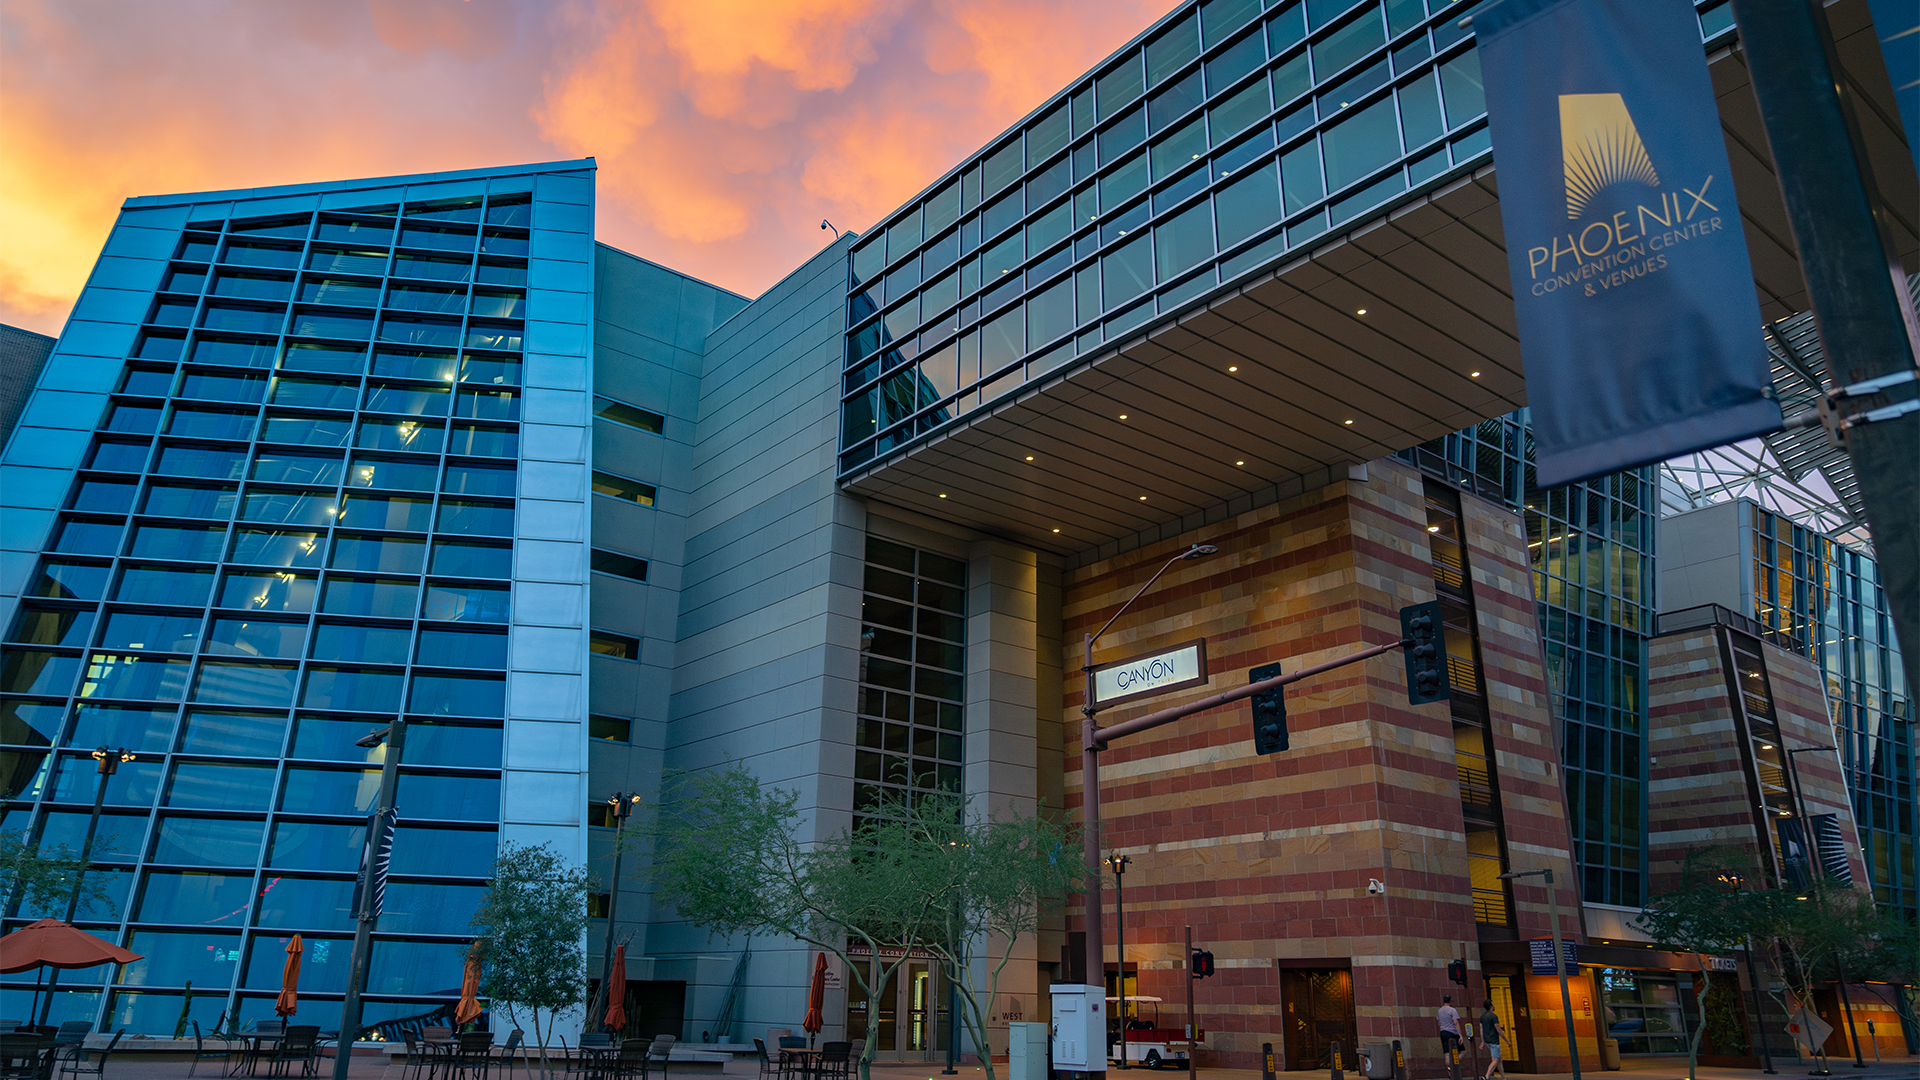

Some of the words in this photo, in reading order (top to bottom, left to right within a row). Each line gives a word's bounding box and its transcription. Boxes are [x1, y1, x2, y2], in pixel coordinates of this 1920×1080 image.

[1528, 175, 1719, 279] PHOENIX
[1531, 242, 1645, 296] CONVENTION
[1649, 217, 1722, 251] CENTER
[1584, 283, 1597, 297] &
[1599, 254, 1668, 289] VENUES
[1117, 659, 1174, 690] CANYON
[1709, 957, 1737, 971] TICKETS
[1002, 1012, 1023, 1021] WEST
